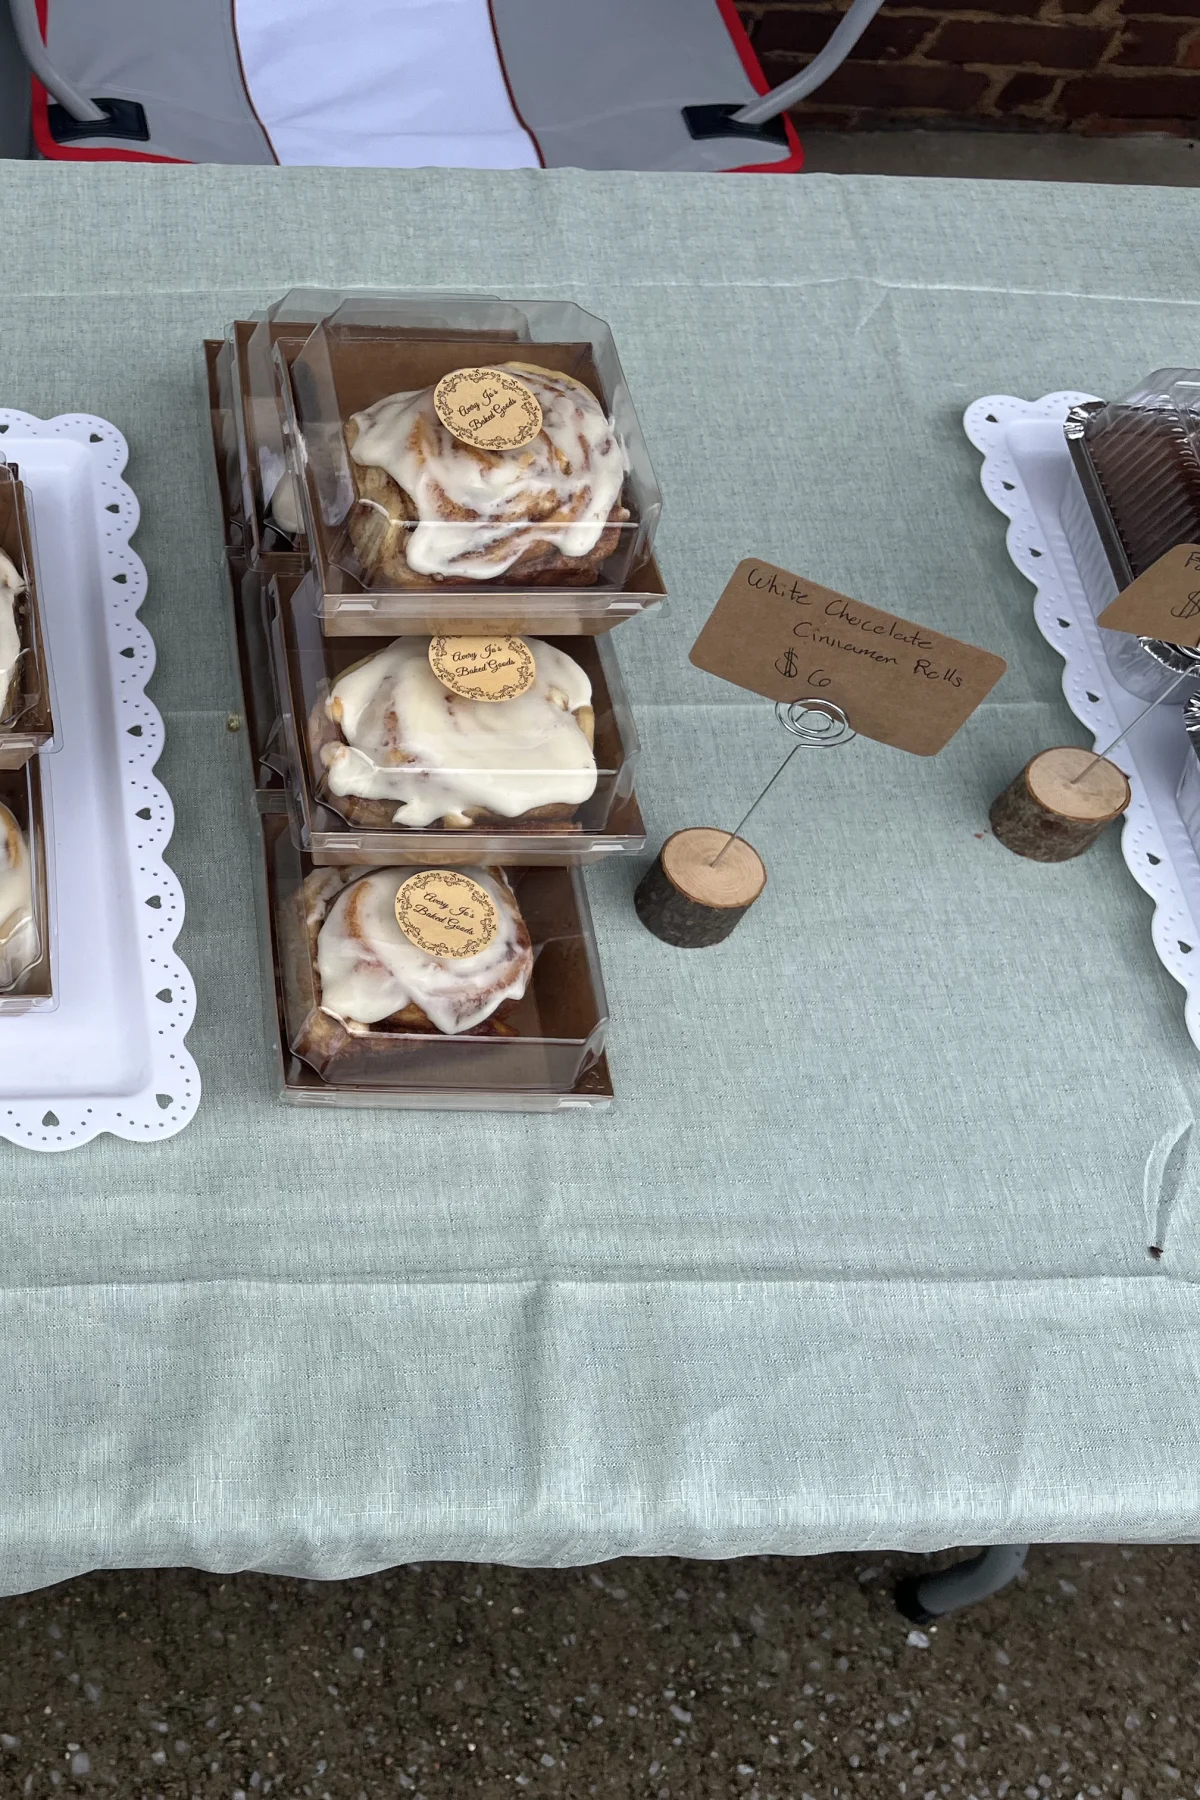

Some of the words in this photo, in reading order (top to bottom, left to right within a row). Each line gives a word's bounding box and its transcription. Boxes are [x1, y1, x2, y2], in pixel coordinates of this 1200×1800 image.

[457, 402, 481, 417] Avery
[481, 388, 499, 407] Jo's
[469, 411, 496, 431] Baked
[491, 397, 517, 418] Goods
[748, 568, 814, 606] White
[825, 599, 934, 650] Chocolate
[451, 651, 477, 662] Avery
[480, 643, 502, 659] Jo's
[455, 664, 487, 677] Baked
[486, 657, 516, 673] Goods
[792, 621, 899, 665] Cinnamon
[914, 659, 964, 688] Rolls
[413, 904, 447, 924] Baked
[444, 917, 475, 935] Goods
[423, 891, 449, 910] Avery
[449, 907, 475, 919] Jo's
